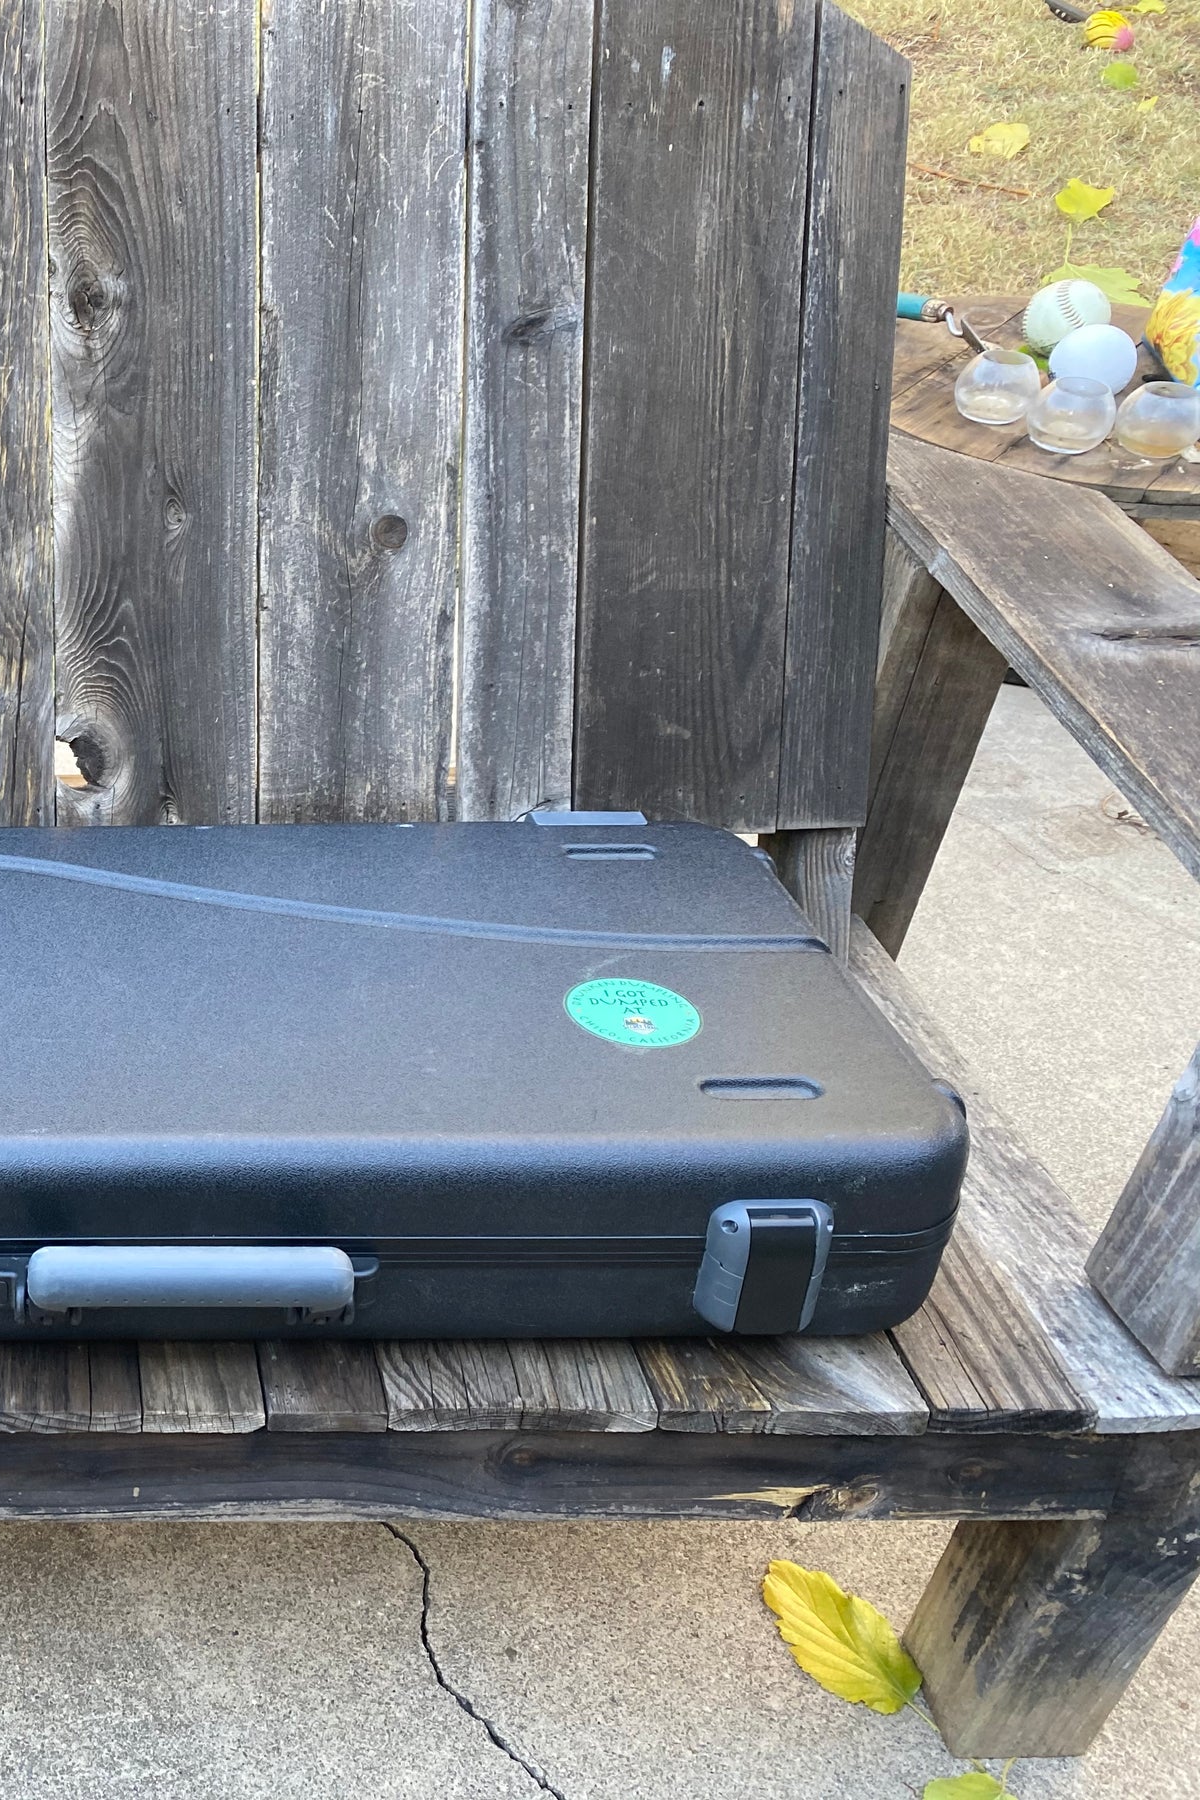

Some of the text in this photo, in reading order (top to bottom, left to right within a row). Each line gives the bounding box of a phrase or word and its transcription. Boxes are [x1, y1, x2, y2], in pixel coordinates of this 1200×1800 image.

[572, 979, 688, 1009] DRUNKEN DUMPLING
[615, 989, 646, 998] GOT
[590, 997, 669, 1007] DUMPED
[623, 1007, 644, 1015] AT
[629, 1018, 695, 1044] CALIFORNIA
